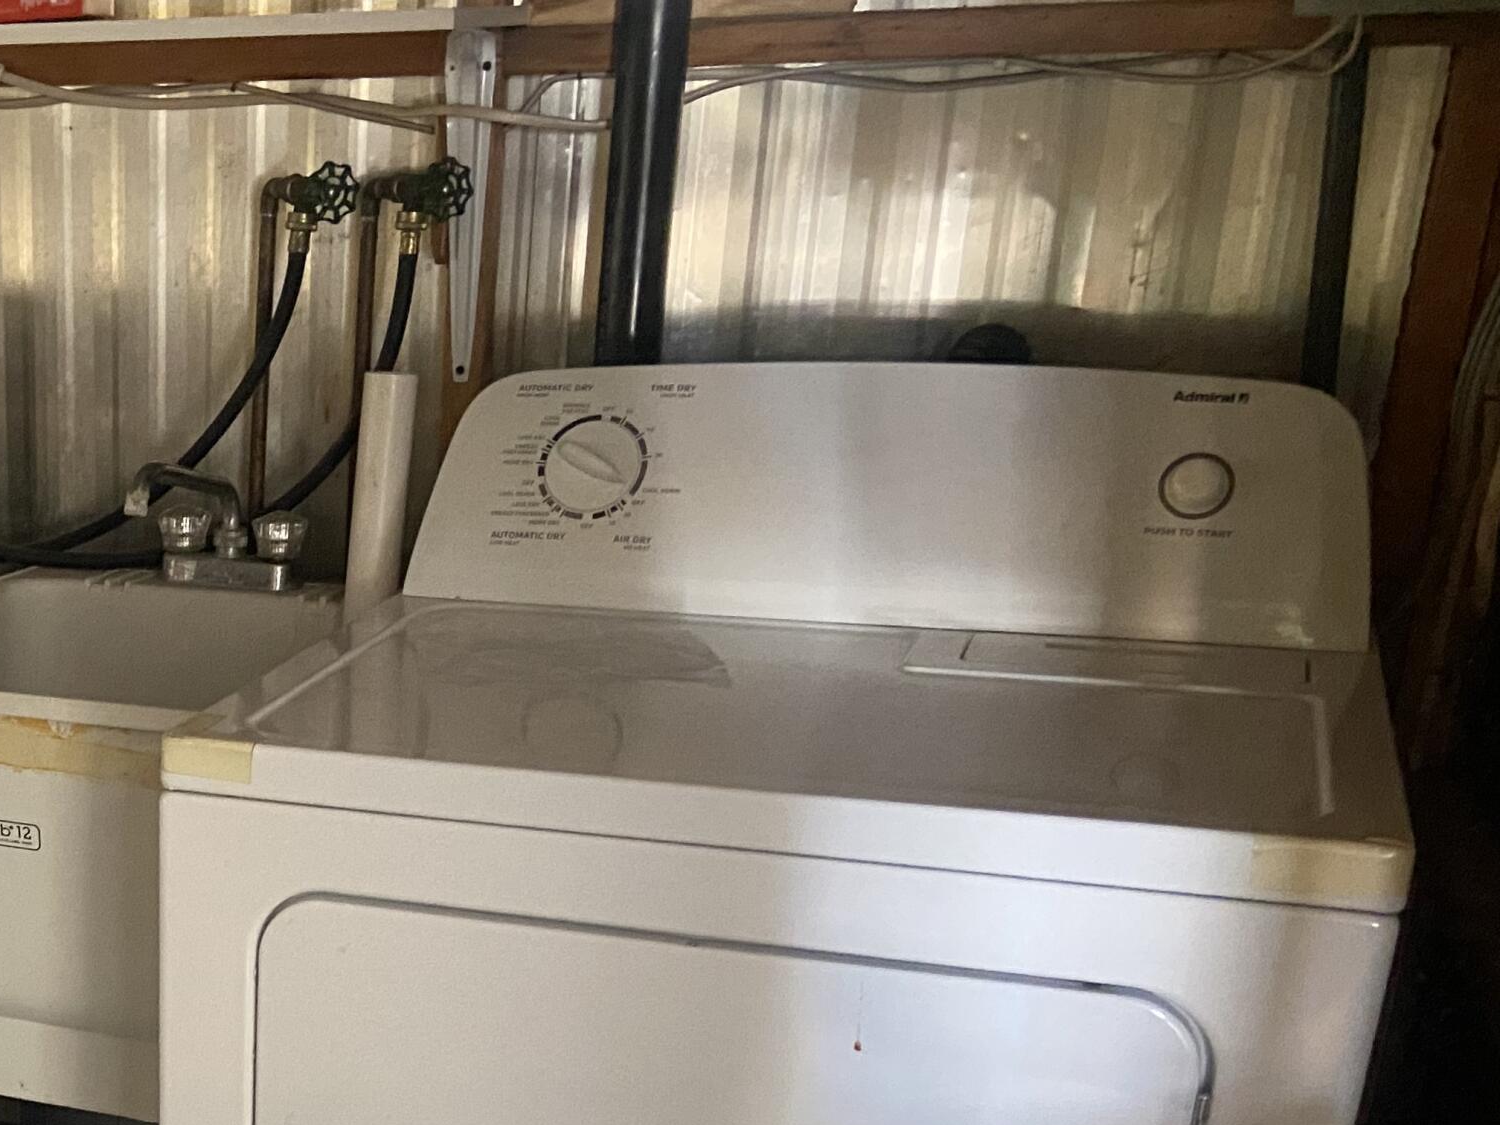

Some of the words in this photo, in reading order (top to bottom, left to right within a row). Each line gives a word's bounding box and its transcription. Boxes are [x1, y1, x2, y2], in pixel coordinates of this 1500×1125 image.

[518, 383, 572, 392] AUTOMATIC
[574, 383, 595, 392] DRY
[651, 383, 675, 392] TIME
[676, 383, 697, 392] DRY
[1173, 390, 1235, 404] Admiral
[490, 530, 545, 540] AUTOMATIC
[546, 532, 566, 540] DRY
[1143, 527, 1176, 536] PUSH
[1179, 527, 1195, 537] TO
[1196, 528, 1234, 538] START
[612, 534, 630, 543] AIR
[631, 535, 652, 544] DRY
[16, 825, 32, 840] 12
